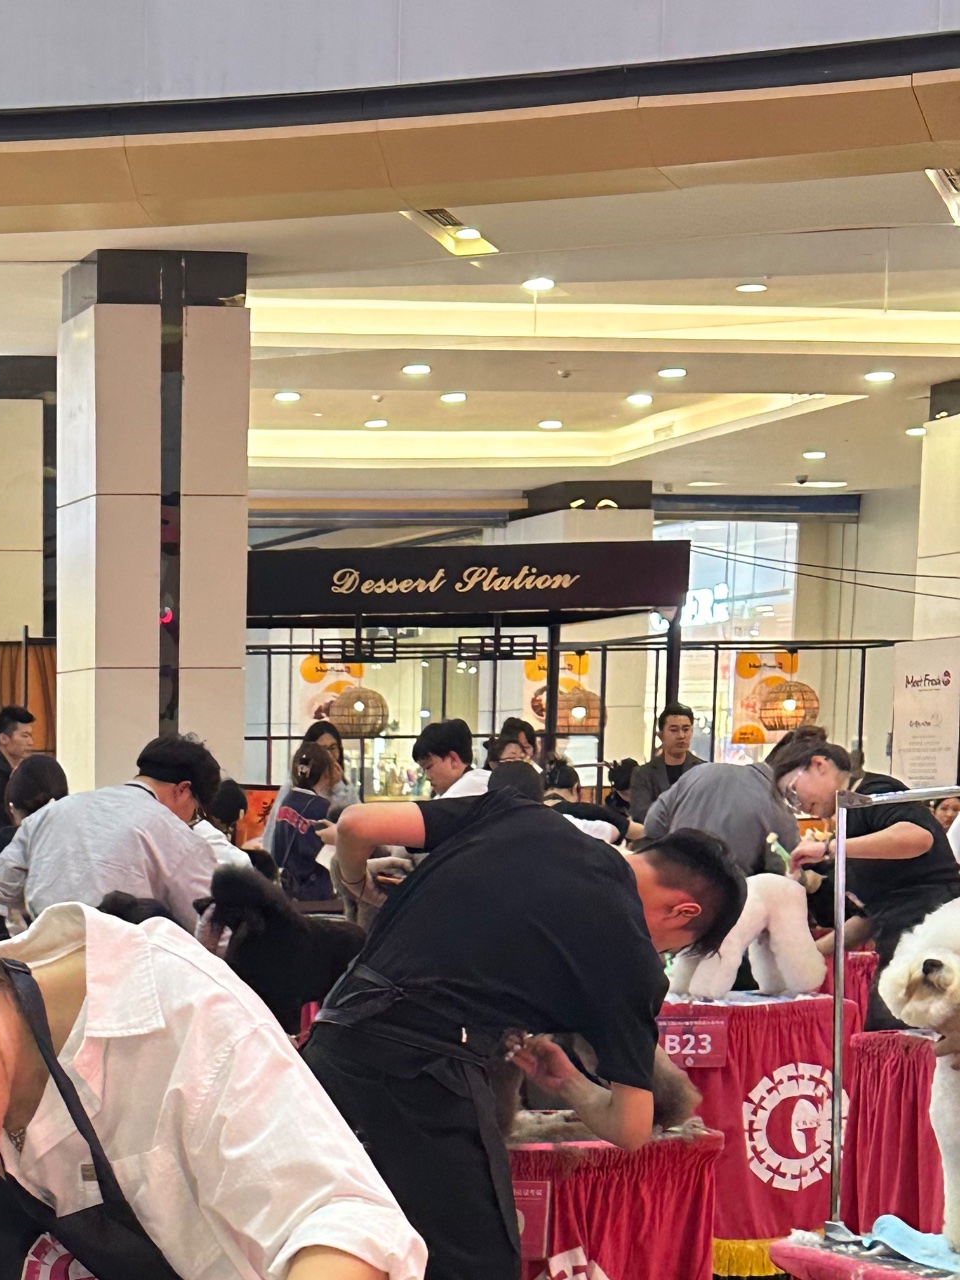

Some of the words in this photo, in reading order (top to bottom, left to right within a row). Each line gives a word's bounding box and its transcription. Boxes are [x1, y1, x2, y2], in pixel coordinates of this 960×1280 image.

[331, 568, 447, 594] Dessert
[454, 565, 581, 593] Station
[664, 1033, 712, 1055] B23
